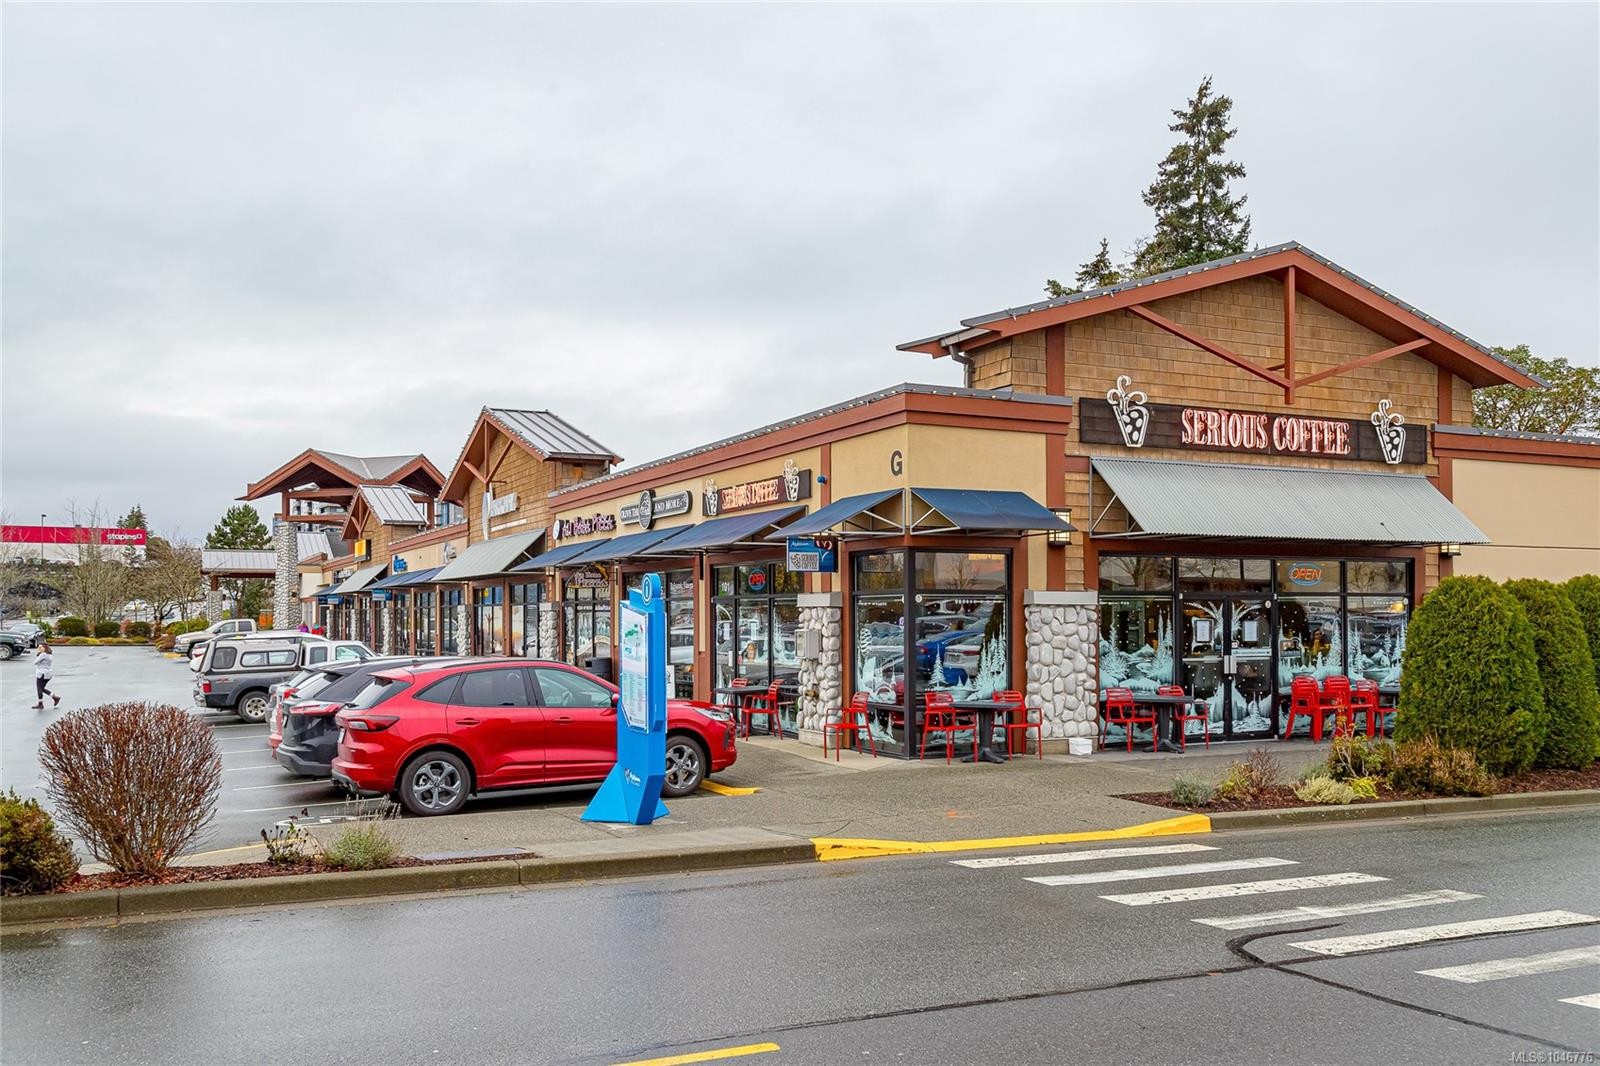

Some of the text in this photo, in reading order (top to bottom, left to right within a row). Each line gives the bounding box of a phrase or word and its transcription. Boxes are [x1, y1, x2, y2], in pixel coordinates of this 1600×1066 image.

[1181, 408, 1351, 455] SERIOUS COFFEE
[890, 450, 903, 476] G
[654, 501, 665, 512] AND
[748, 573, 766, 585] OPEN
[1290, 567, 1322, 581] OPEN
